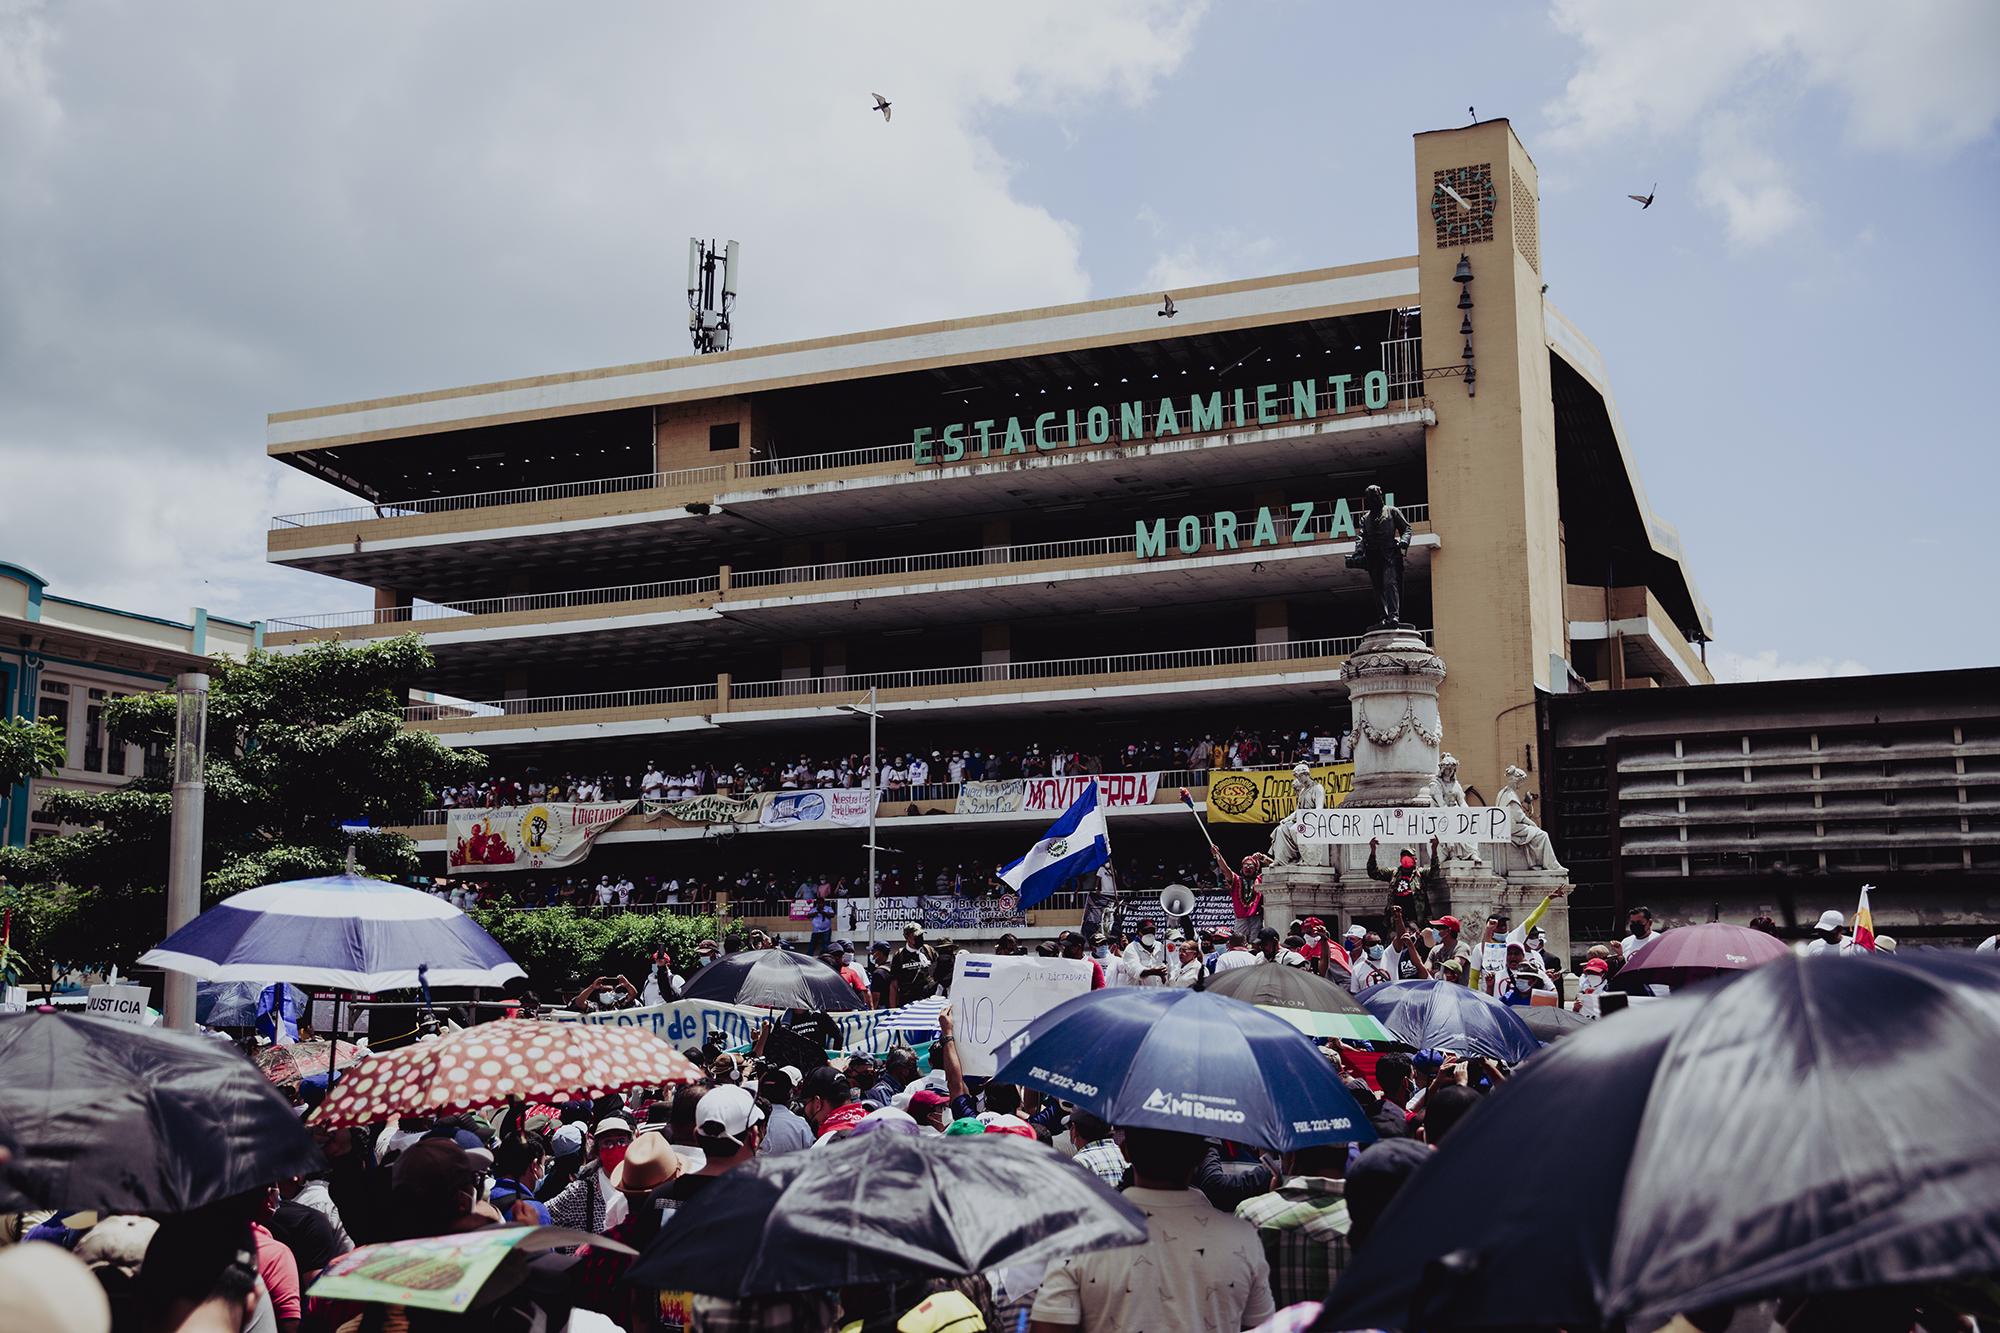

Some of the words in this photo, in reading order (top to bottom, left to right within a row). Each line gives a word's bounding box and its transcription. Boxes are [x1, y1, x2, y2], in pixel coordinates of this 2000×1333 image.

[913, 369, 1389, 466] ESTACIONAMIENTO
[1135, 493, 1394, 559] MORAZA
[1223, 786, 1246, 796] CSS
[1301, 811, 1362, 839] SACAR
[1372, 813, 1395, 836] AL
[1456, 813, 1480, 835] DE
[926, 900, 941, 909] NO
[959, 899, 998, 909] Bitcoin
[926, 911, 939, 920] NO
[926, 921, 940, 929] NO
[87, 998, 141, 1014] JUSTICIA
[1272, 999, 1305, 1007] AVON
[668, 1009, 697, 1040] de
[959, 996, 994, 1045] NO
[1048, 1073, 1099, 1097] 2212-1800
[1193, 1101, 1246, 1124] Banco
